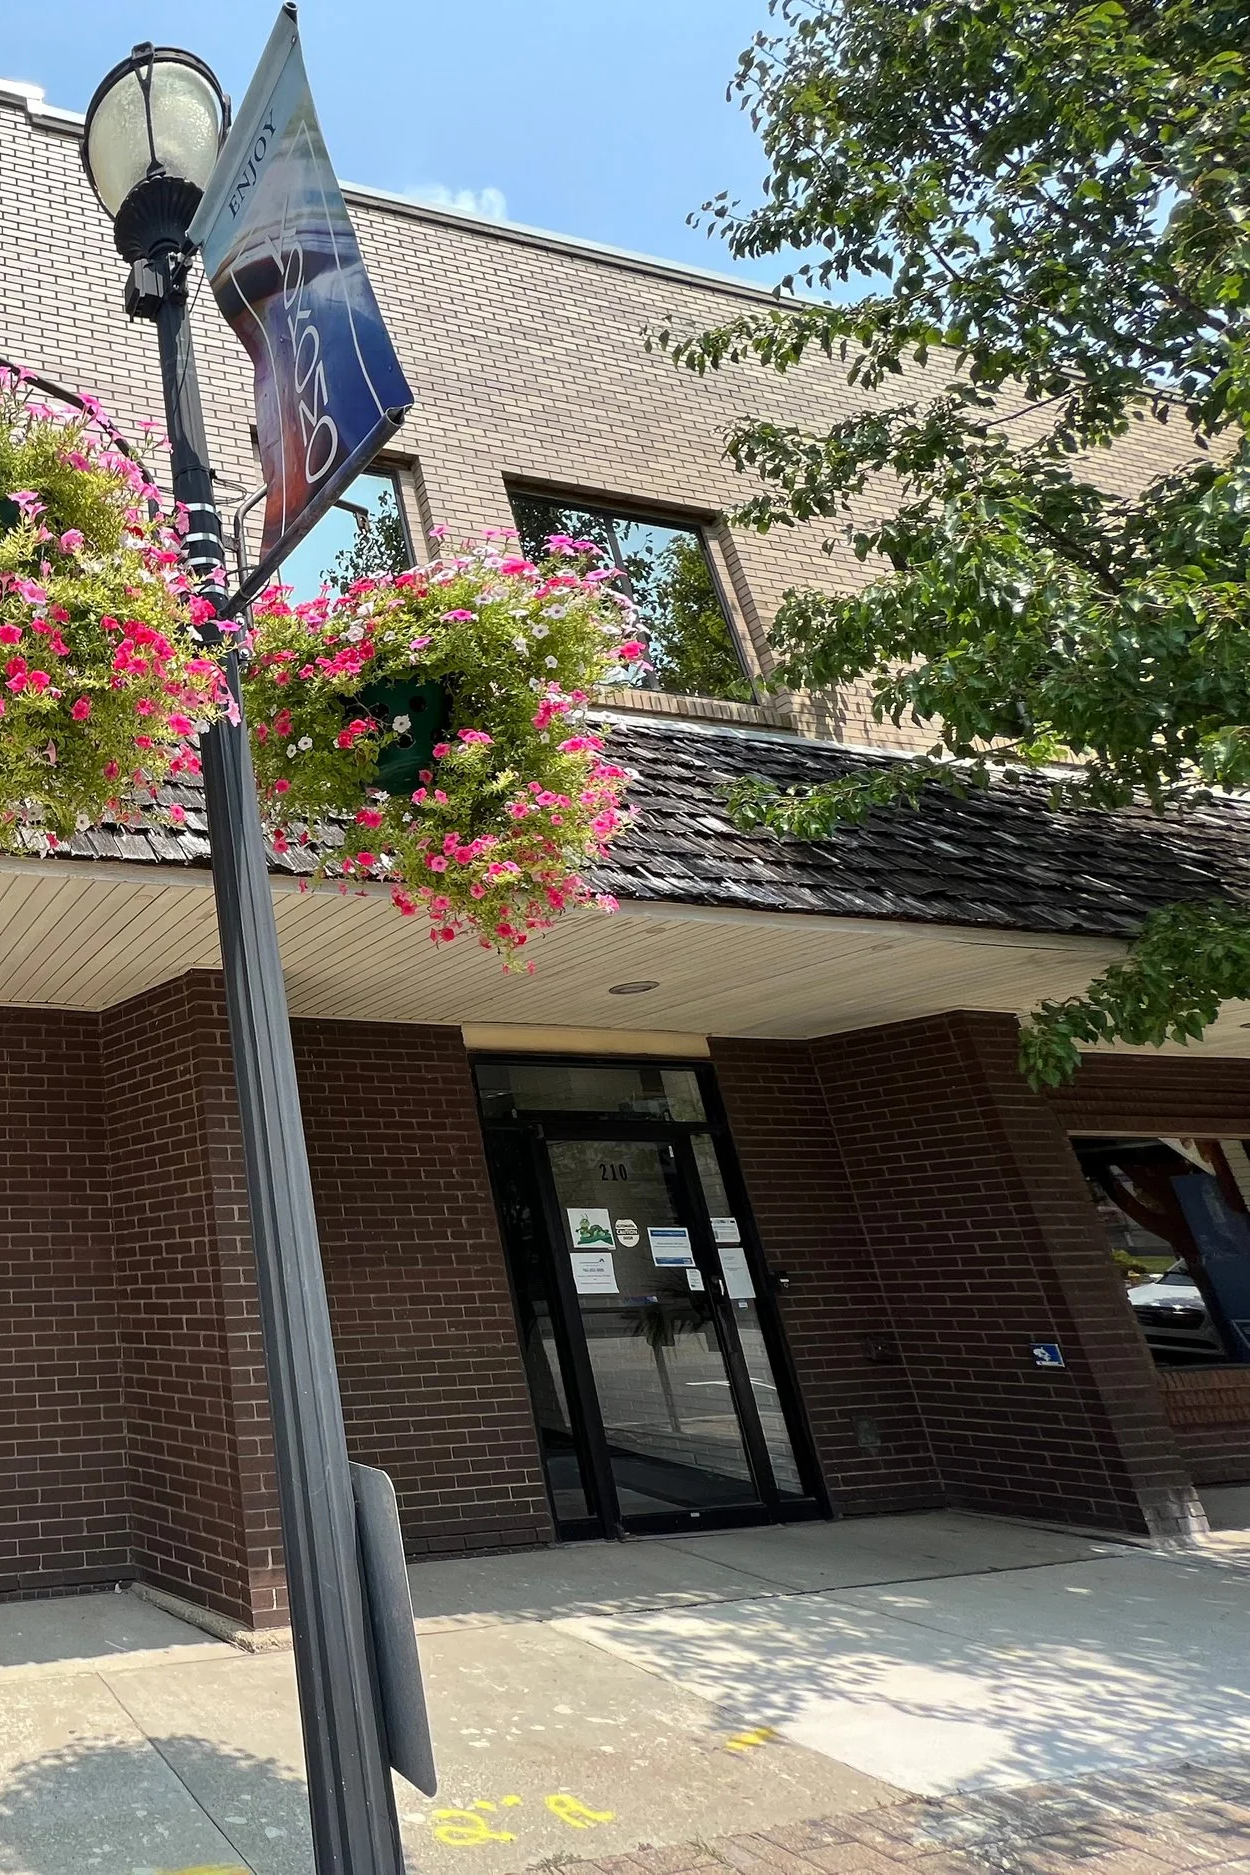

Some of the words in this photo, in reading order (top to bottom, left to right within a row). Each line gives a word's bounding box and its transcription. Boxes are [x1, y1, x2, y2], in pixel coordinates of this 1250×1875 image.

[229, 110, 278, 219] ENJOY
[264, 194, 338, 484] KOKOMO
[599, 1163, 628, 1181] 210
